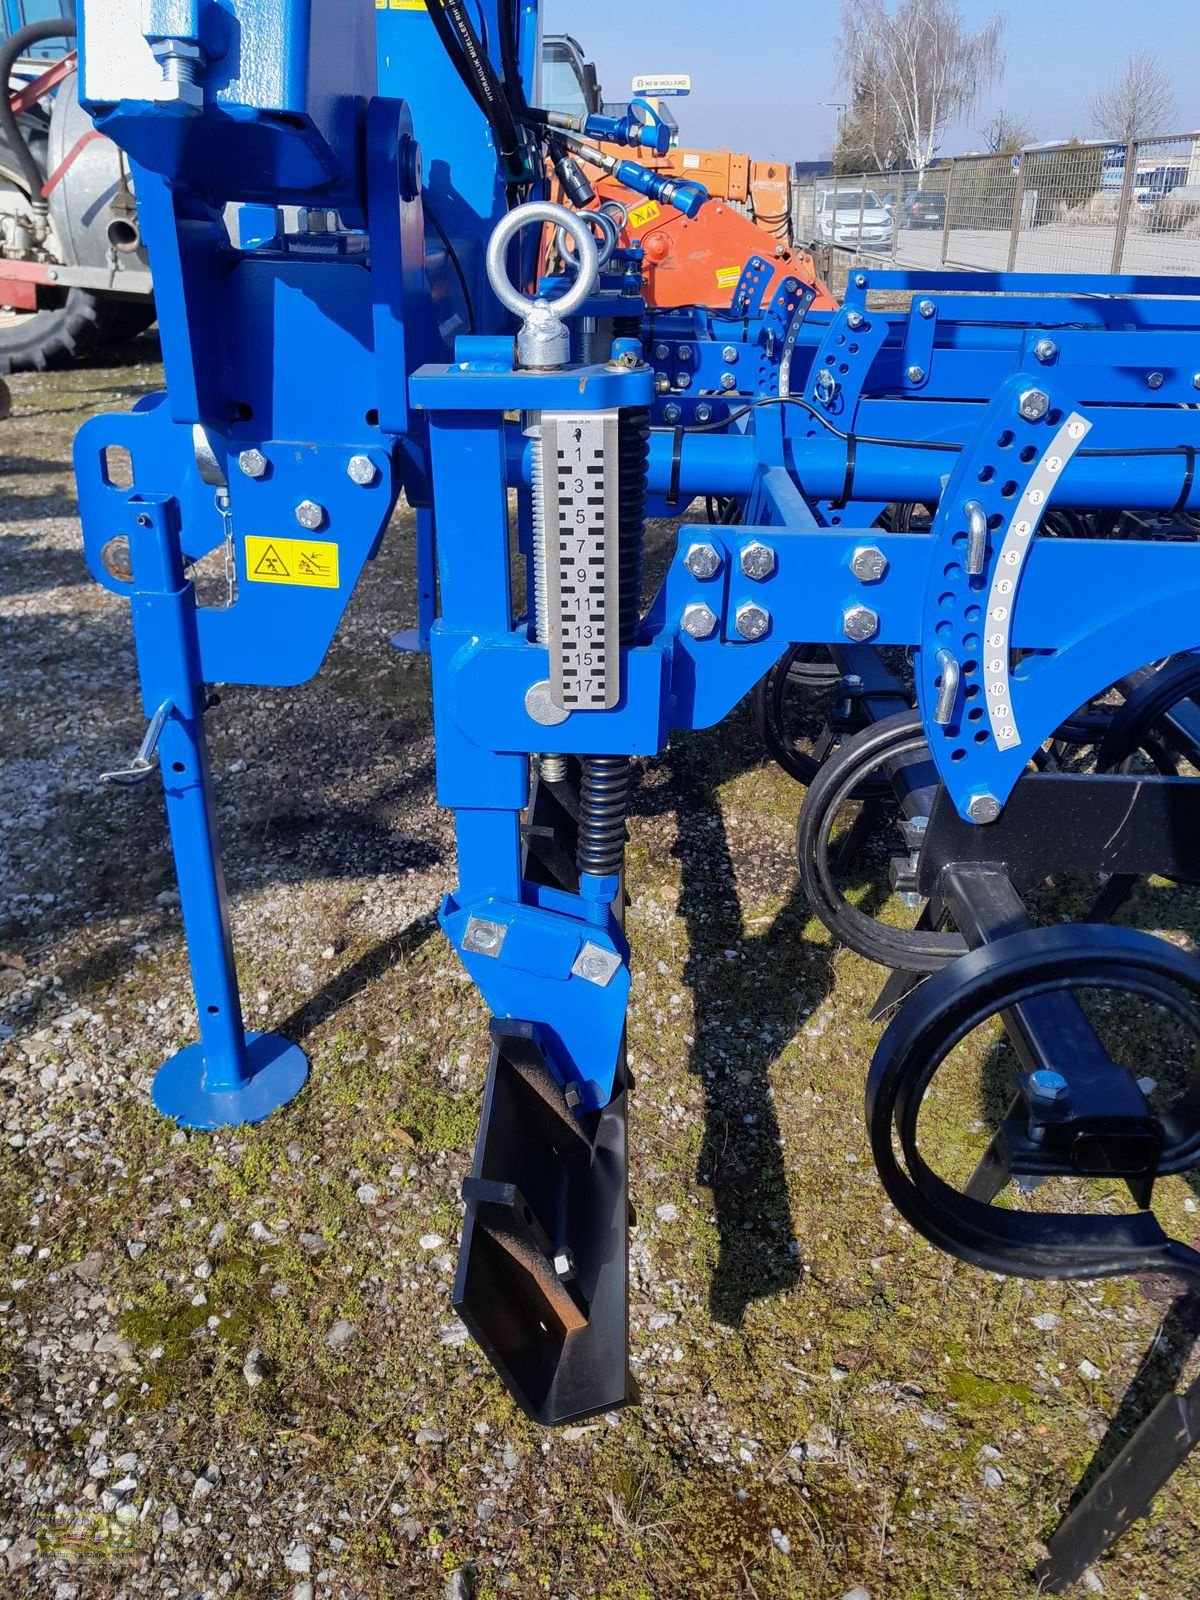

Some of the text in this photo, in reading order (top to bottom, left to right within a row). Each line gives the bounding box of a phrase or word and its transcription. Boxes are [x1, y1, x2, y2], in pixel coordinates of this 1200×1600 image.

[458, 21, 477, 58] MUELLER
[473, 58, 494, 102] HYDRAULIK
[1073, 424, 1080, 436] 1
[576, 447, 582, 462] 1
[1051, 459, 1058, 470] 2
[574, 478, 584, 493] 3
[1033, 492, 1041, 503] 3
[576, 509, 585, 524] 5
[1018, 523, 1026, 533] 4
[577, 539, 586, 553] 7
[1009, 553, 1016, 563] 5
[577, 569, 587, 583] 9
[1002, 582, 1009, 592] 6
[574, 597, 592, 611] 11
[997, 609, 1004, 619] 7
[574, 625, 593, 639] 13
[994, 636, 1001, 645] 8
[575, 652, 593, 666] 15
[994, 661, 1001, 670] 9
[575, 679, 593, 692] 17
[993, 684, 1004, 694] 10
[996, 706, 1007, 716] 11
[1002, 727, 1013, 737] 12
